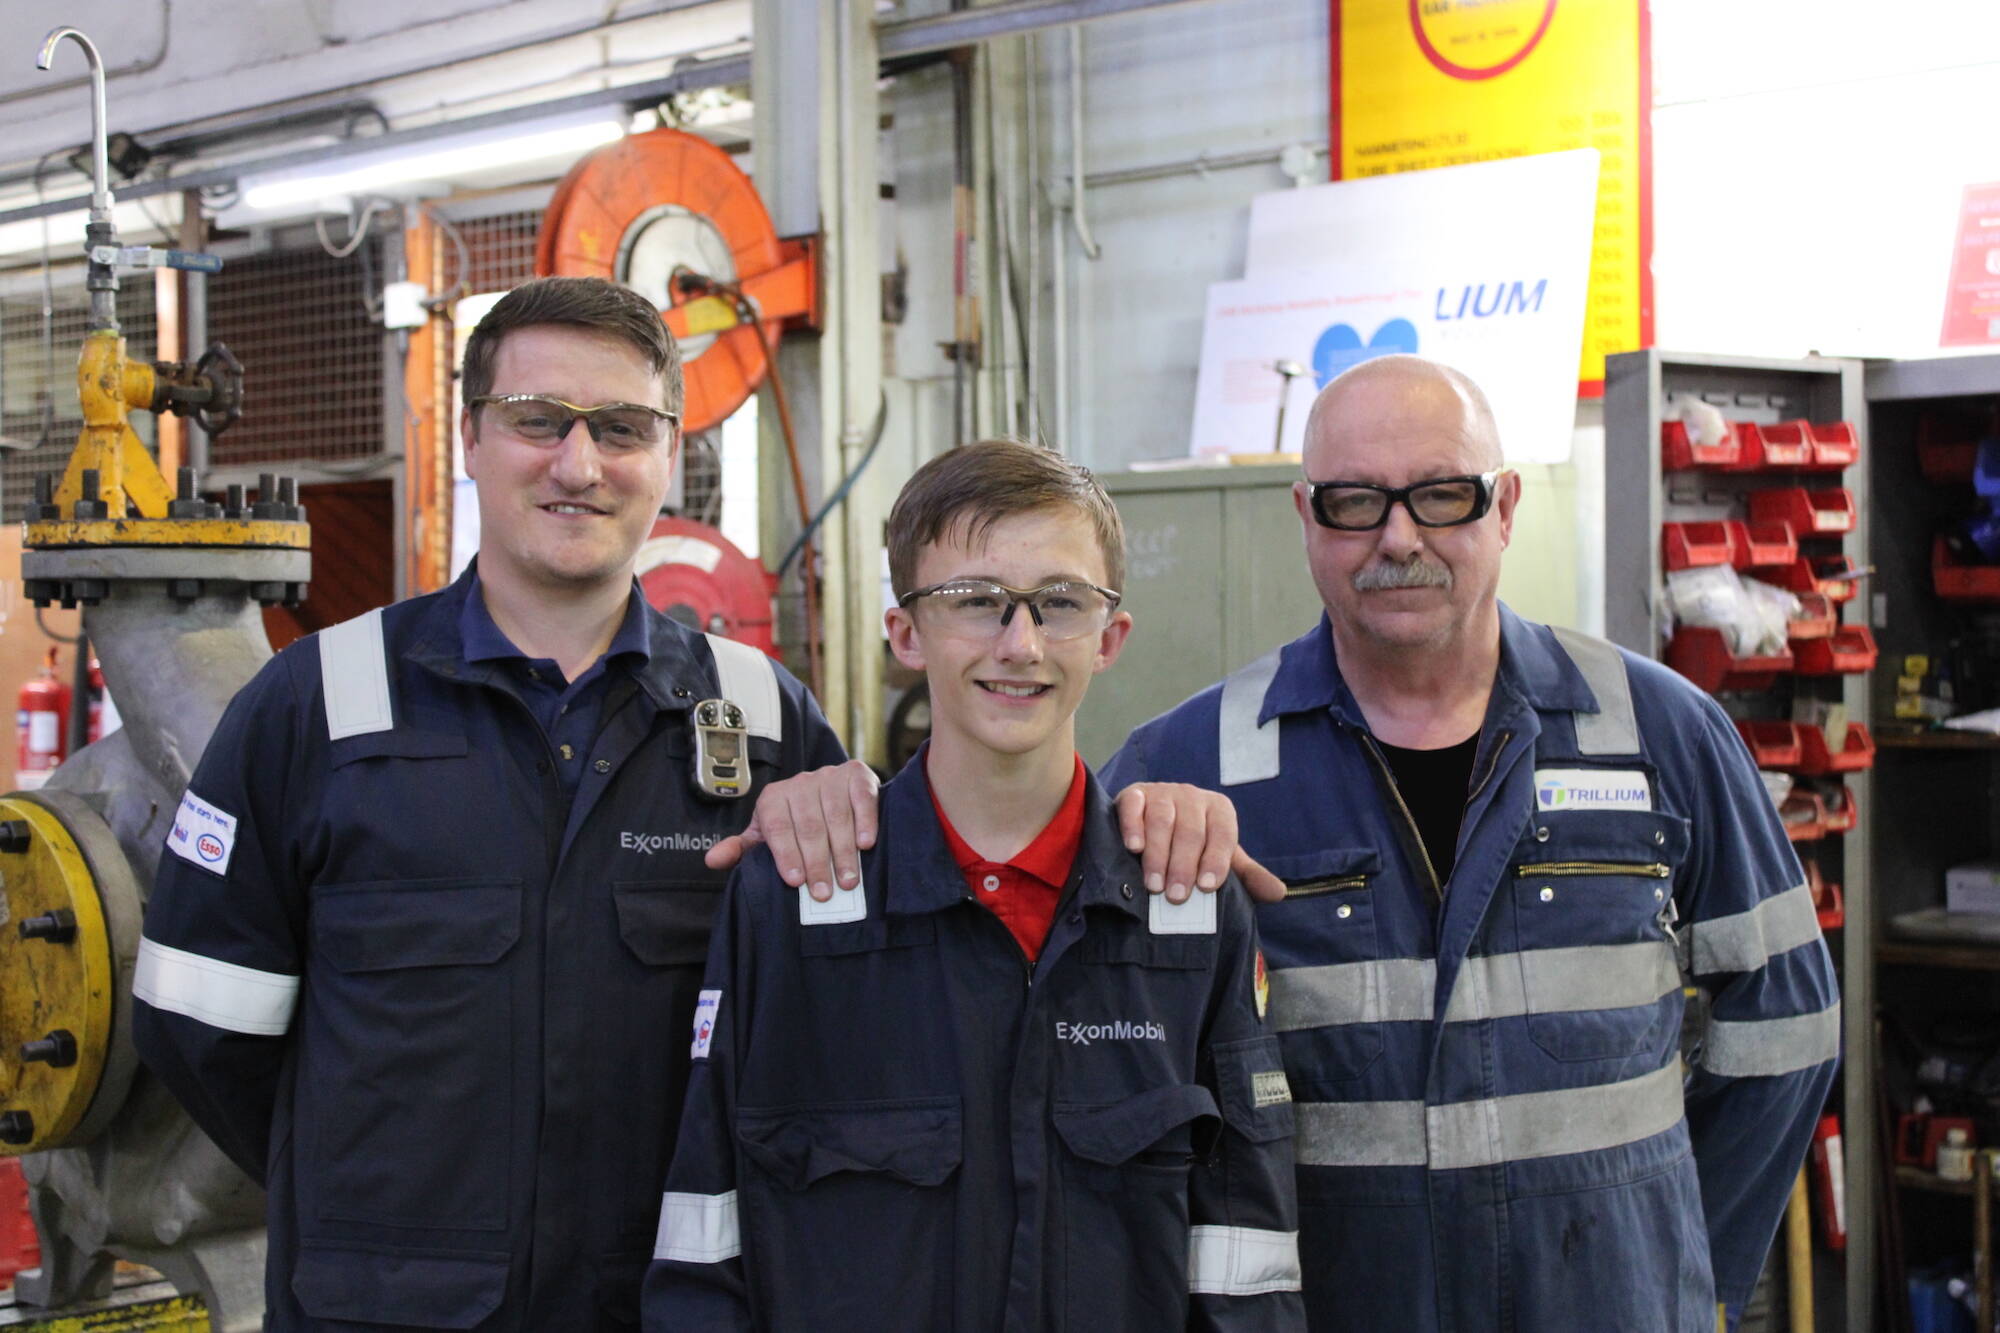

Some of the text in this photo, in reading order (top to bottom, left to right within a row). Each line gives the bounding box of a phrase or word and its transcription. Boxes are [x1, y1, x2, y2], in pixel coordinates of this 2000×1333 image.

[1435, 278, 1548, 321] LIUM
[1567, 788, 1645, 801] TRILLIUM
[200, 839, 221, 856] Esso
[1056, 1020, 1166, 1046] ExxonMobil
